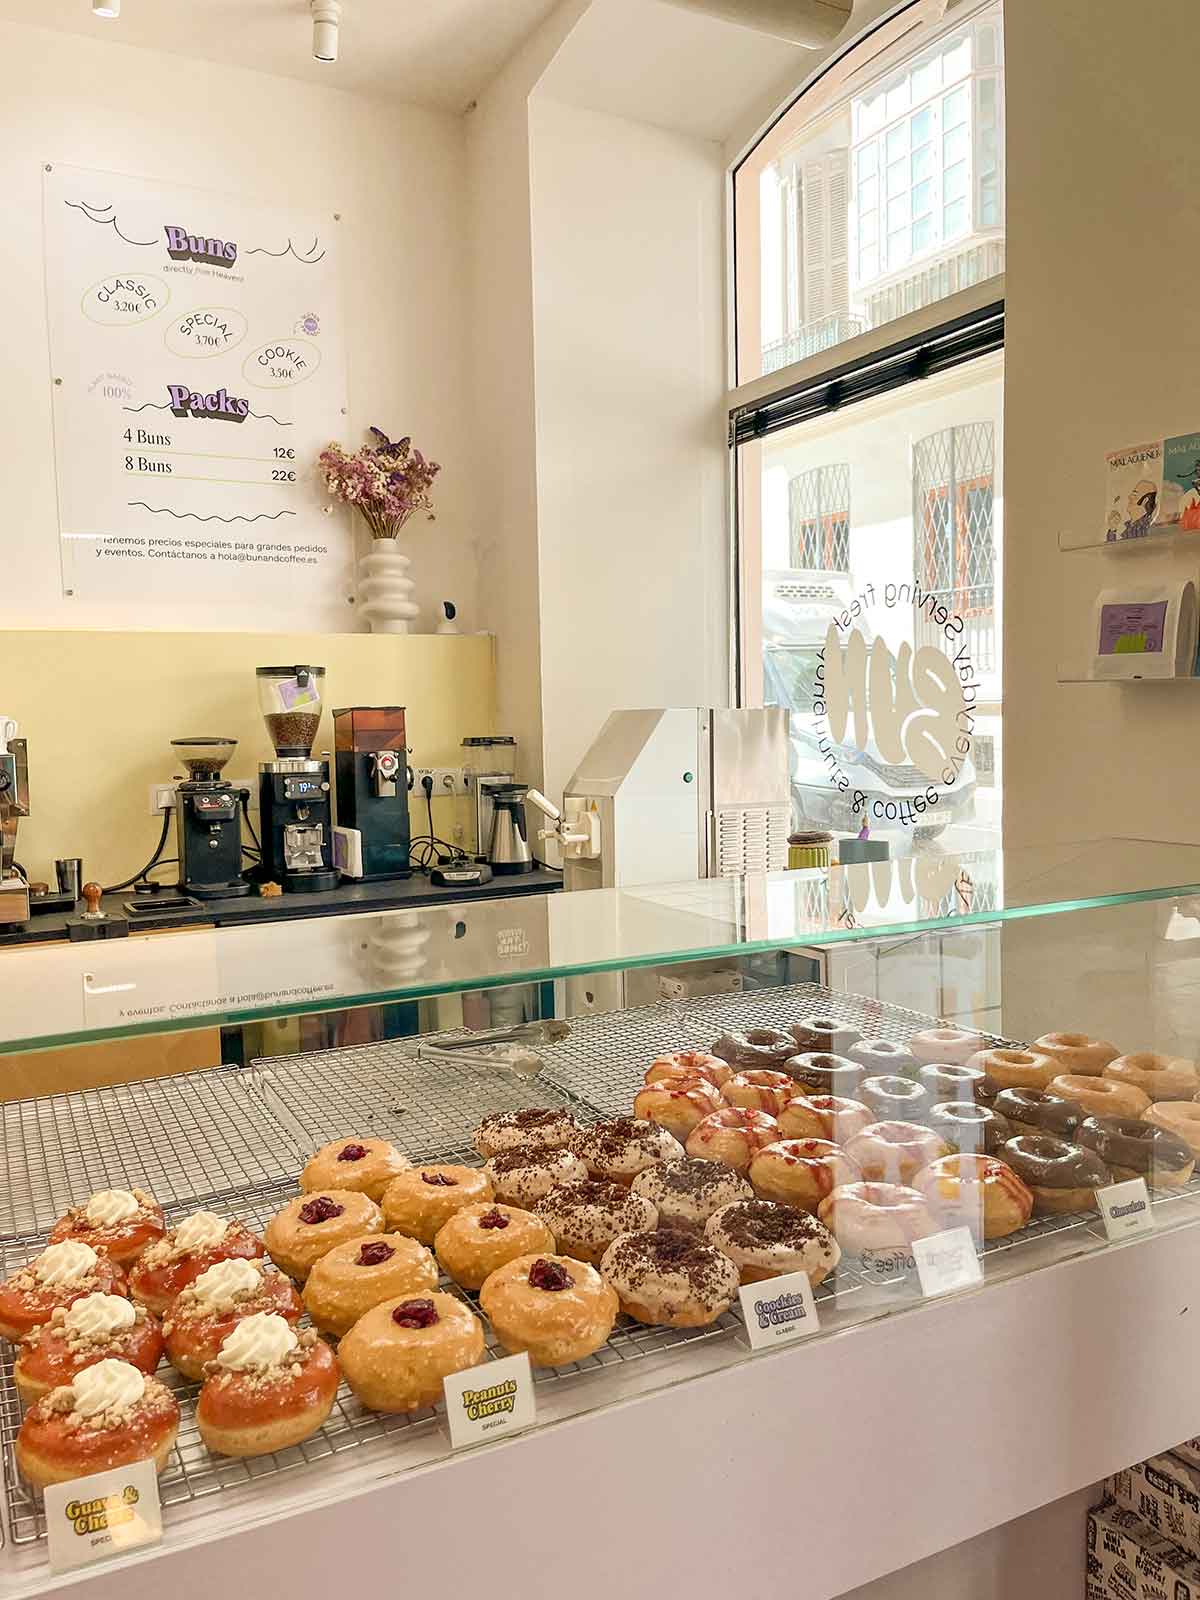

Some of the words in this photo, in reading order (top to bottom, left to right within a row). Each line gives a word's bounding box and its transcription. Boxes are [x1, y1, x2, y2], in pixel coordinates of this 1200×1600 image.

[164, 225, 237, 268] Buns
[97, 279, 156, 309] CLASSIC
[113, 300, 142, 314] 3.20€
[180, 313, 233, 342] SPECIAL
[195, 333, 220, 347] 3.70€
[258, 346, 307, 371] COOKIE
[269, 367, 295, 379] 3.50€
[167, 385, 249, 423] Packs
[123, 428, 132, 443] 4
[137, 429, 171, 447] Buns
[273, 447, 295, 460] 12€
[125, 455, 134, 471] 8
[138, 456, 172, 474] Buns
[271, 469, 296, 482] 22€
[95, 548, 102, 558] y
[104, 547, 146, 558] eventos.
[147, 548, 208, 560] Contáctanos
[209, 552, 216, 560] a
[148, 538, 182, 548] precios
[184, 539, 232, 549] especiales
[234, 541, 254, 550] para
[256, 542, 292, 552] grandes
[294, 543, 328, 553] pedidos
[769, 1306, 807, 1325] Cream
[462, 1380, 517, 1408] Peanuts
[467, 1395, 516, 1421] Cherry
[481, 1418, 508, 1431] SPECIAL
[122, 1484, 139, 1505] &
